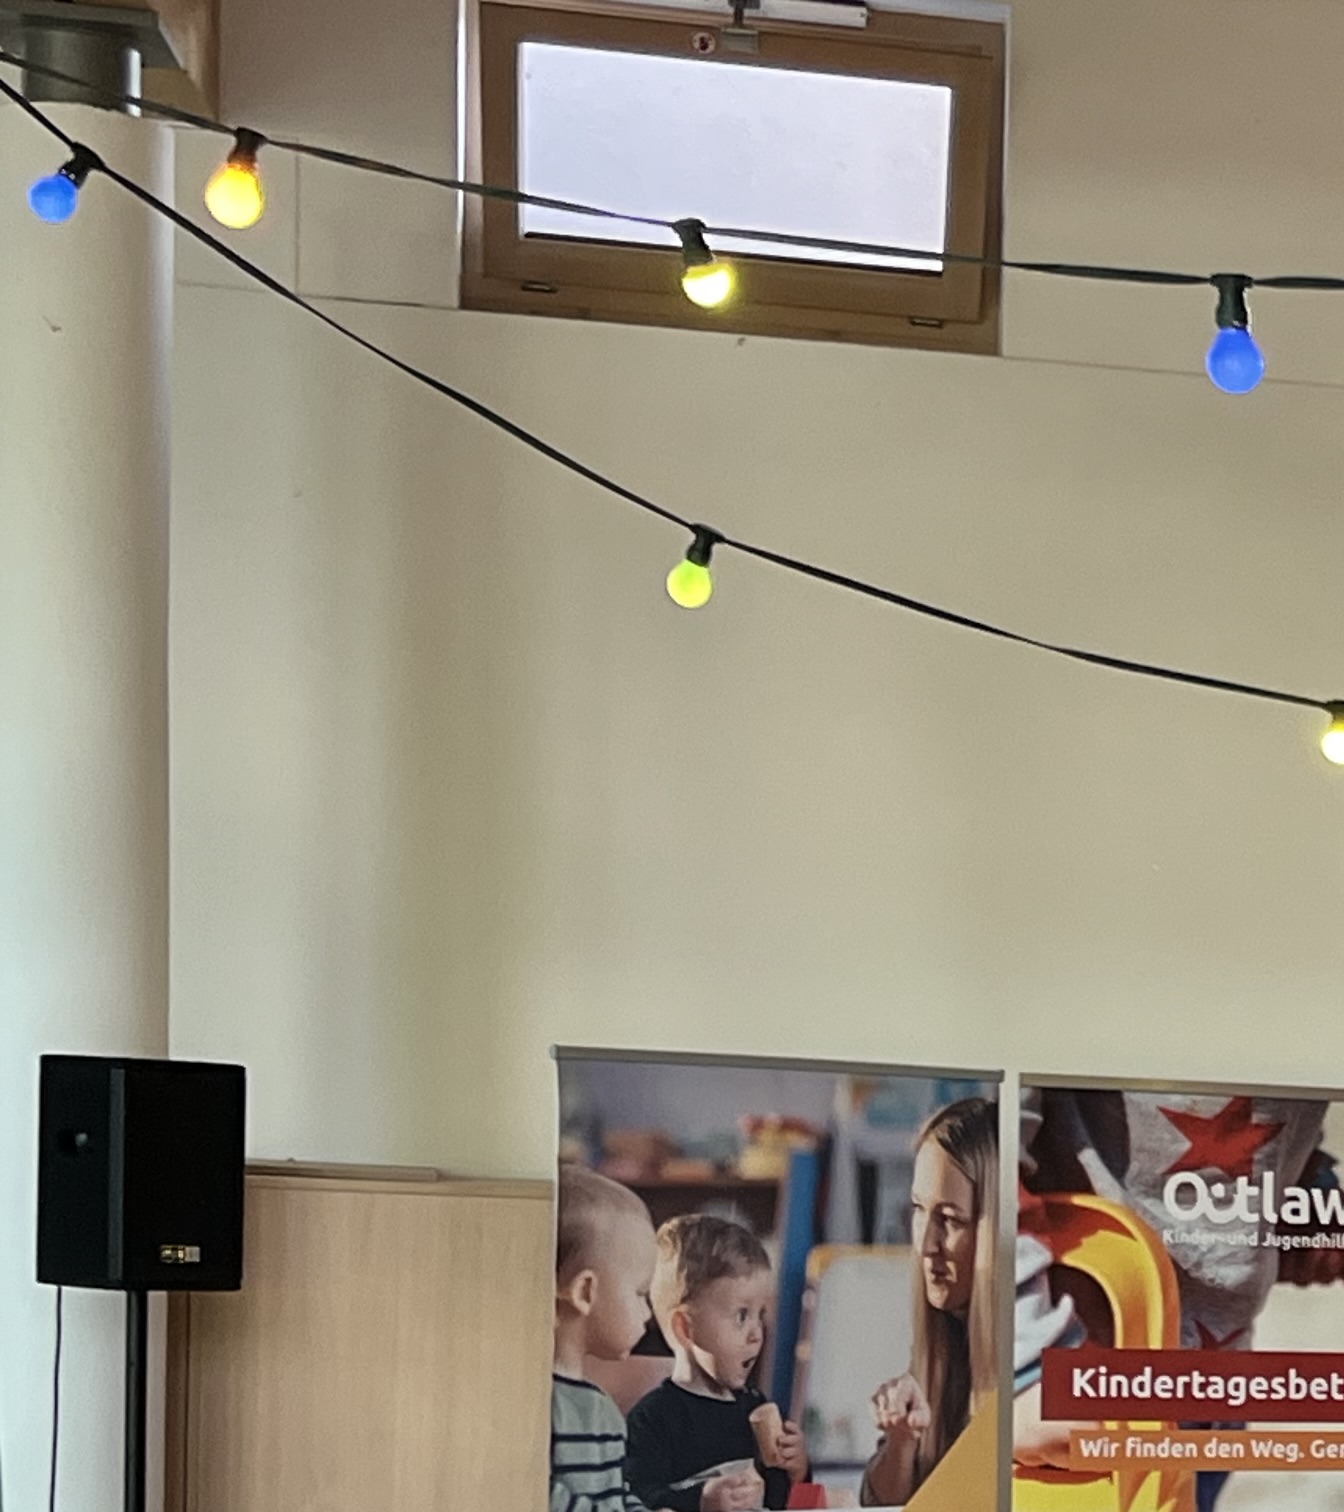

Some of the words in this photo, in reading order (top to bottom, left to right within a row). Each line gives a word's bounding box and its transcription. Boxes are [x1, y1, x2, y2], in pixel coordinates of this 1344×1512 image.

[1228, 1231, 1259, 1247] und
[1079, 1438, 1119, 1458] Wir
[1125, 1438, 1198, 1458] finden
[1204, 1438, 1245, 1458] den
[1250, 1439, 1304, 1462] Weg.
